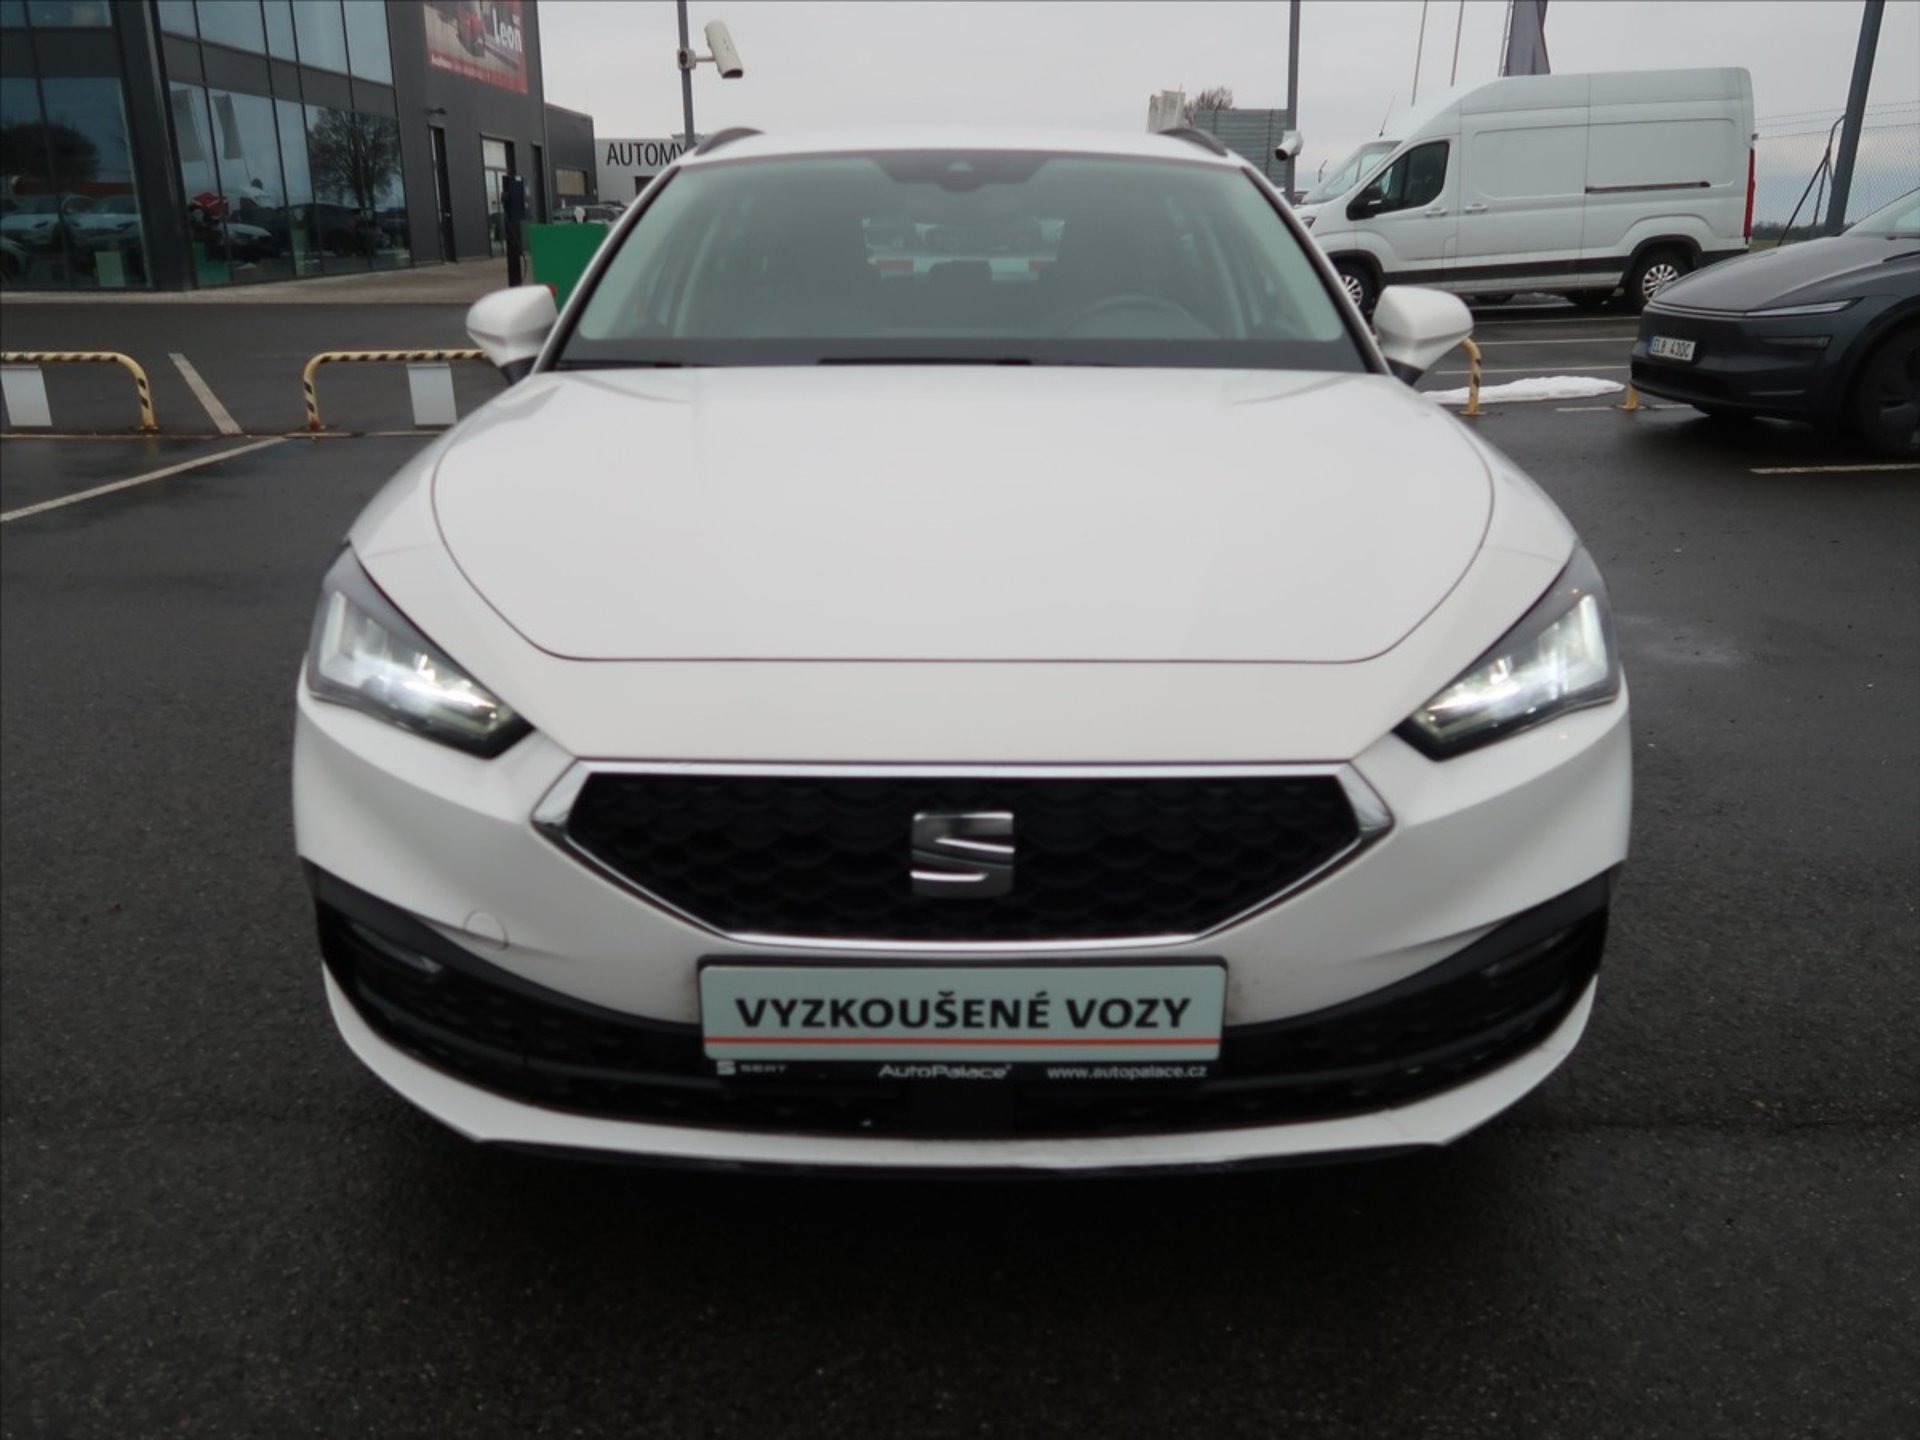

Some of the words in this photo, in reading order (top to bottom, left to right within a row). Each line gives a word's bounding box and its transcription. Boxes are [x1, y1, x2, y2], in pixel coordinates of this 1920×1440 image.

[735, 990, 1051, 1029] VYZKOUŠENÉ
[1066, 997, 1191, 1029] VOZY
[1046, 1064, 1209, 1081] www.autopalace.cz
